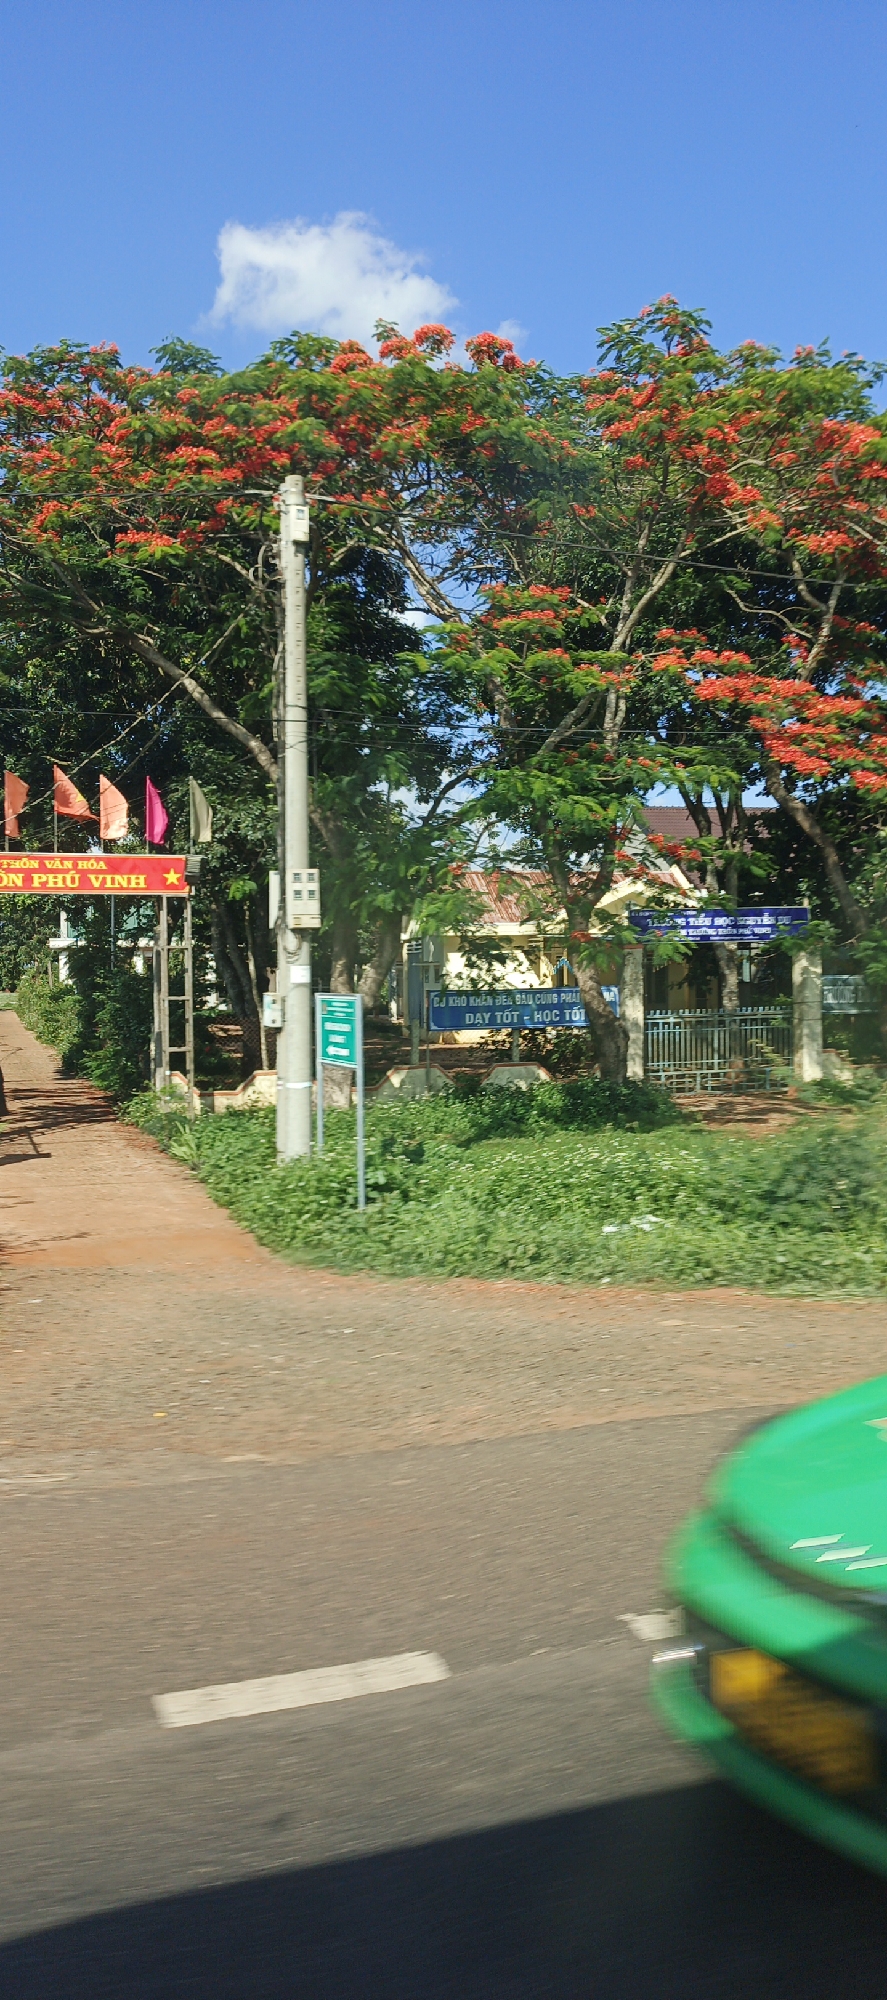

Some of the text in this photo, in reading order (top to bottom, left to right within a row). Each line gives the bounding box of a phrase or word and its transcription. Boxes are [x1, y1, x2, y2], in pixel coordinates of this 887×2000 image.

[43, 857, 73, 869] VĂN
[76, 858, 108, 870] HÓA
[0, 868, 148, 888] ÔN PHÚ VINH
[465, 1012, 491, 1027] DẠY
[495, 1007, 520, 1024] TỐT
[534, 1009, 560, 1024] HỌC
